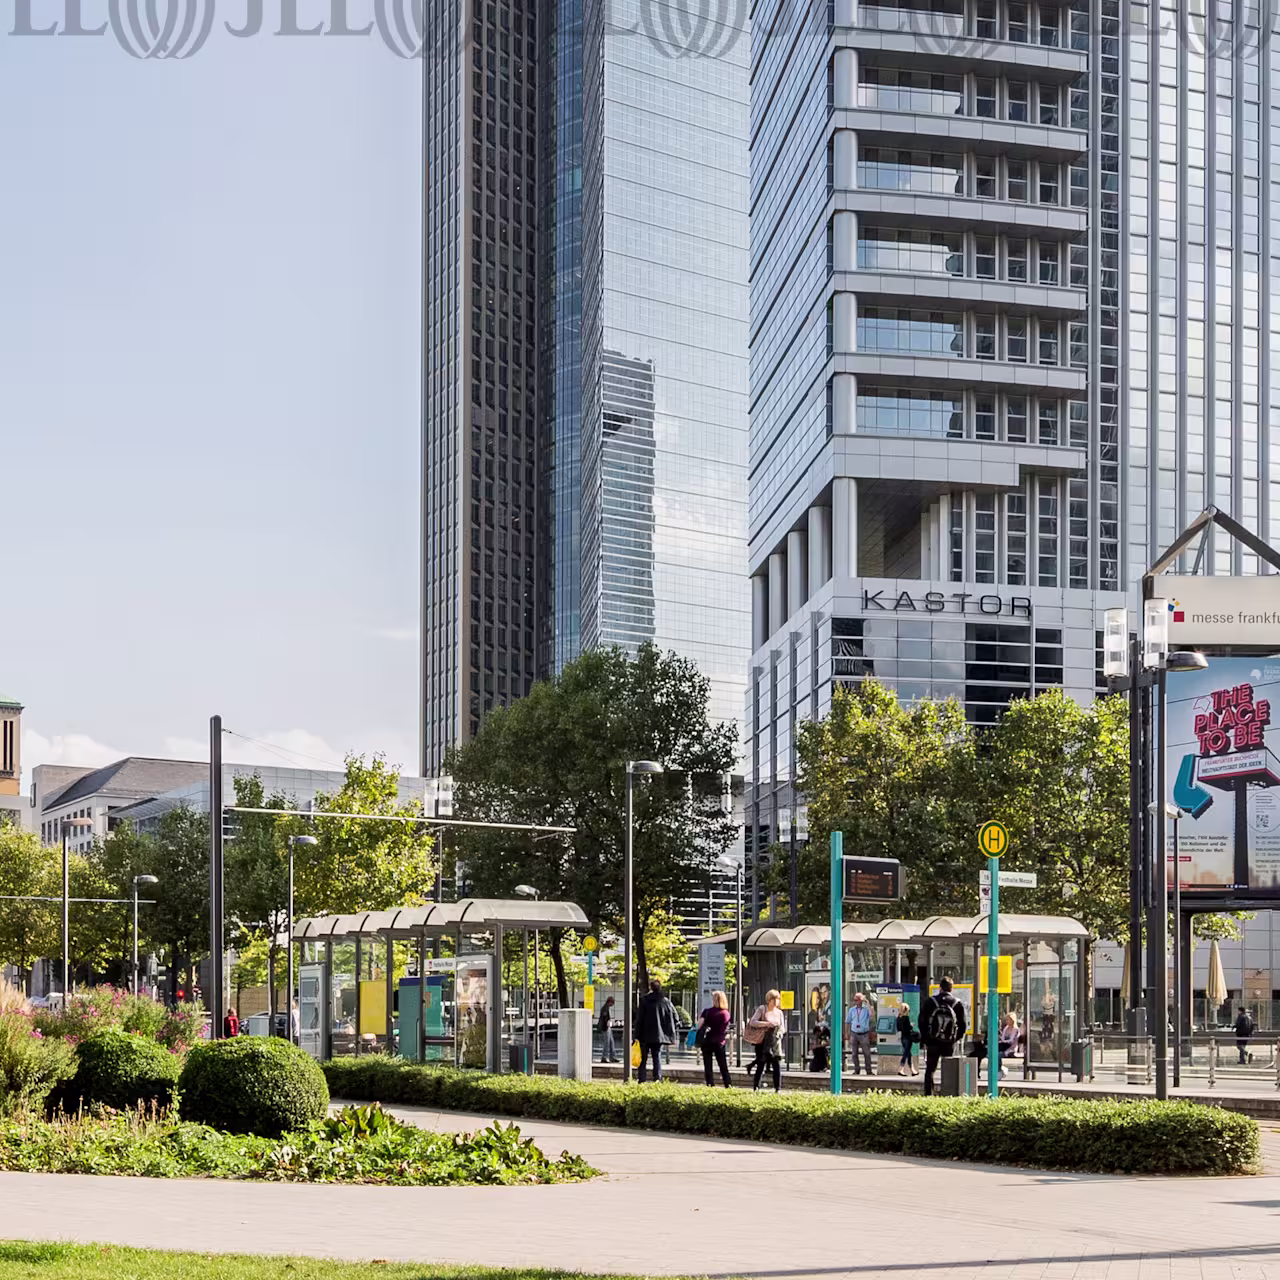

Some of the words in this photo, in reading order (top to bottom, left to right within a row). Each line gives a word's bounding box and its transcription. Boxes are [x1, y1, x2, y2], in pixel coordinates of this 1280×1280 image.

[864, 589, 1032, 619] KASTOR
[1192, 612, 1234, 624] messe
[1211, 683, 1253, 711] THE
[1194, 699, 1271, 736] PLACE
[1197, 730, 1231, 753] TO
[1234, 722, 1265, 748] BE
[989, 829, 1000, 849] H
